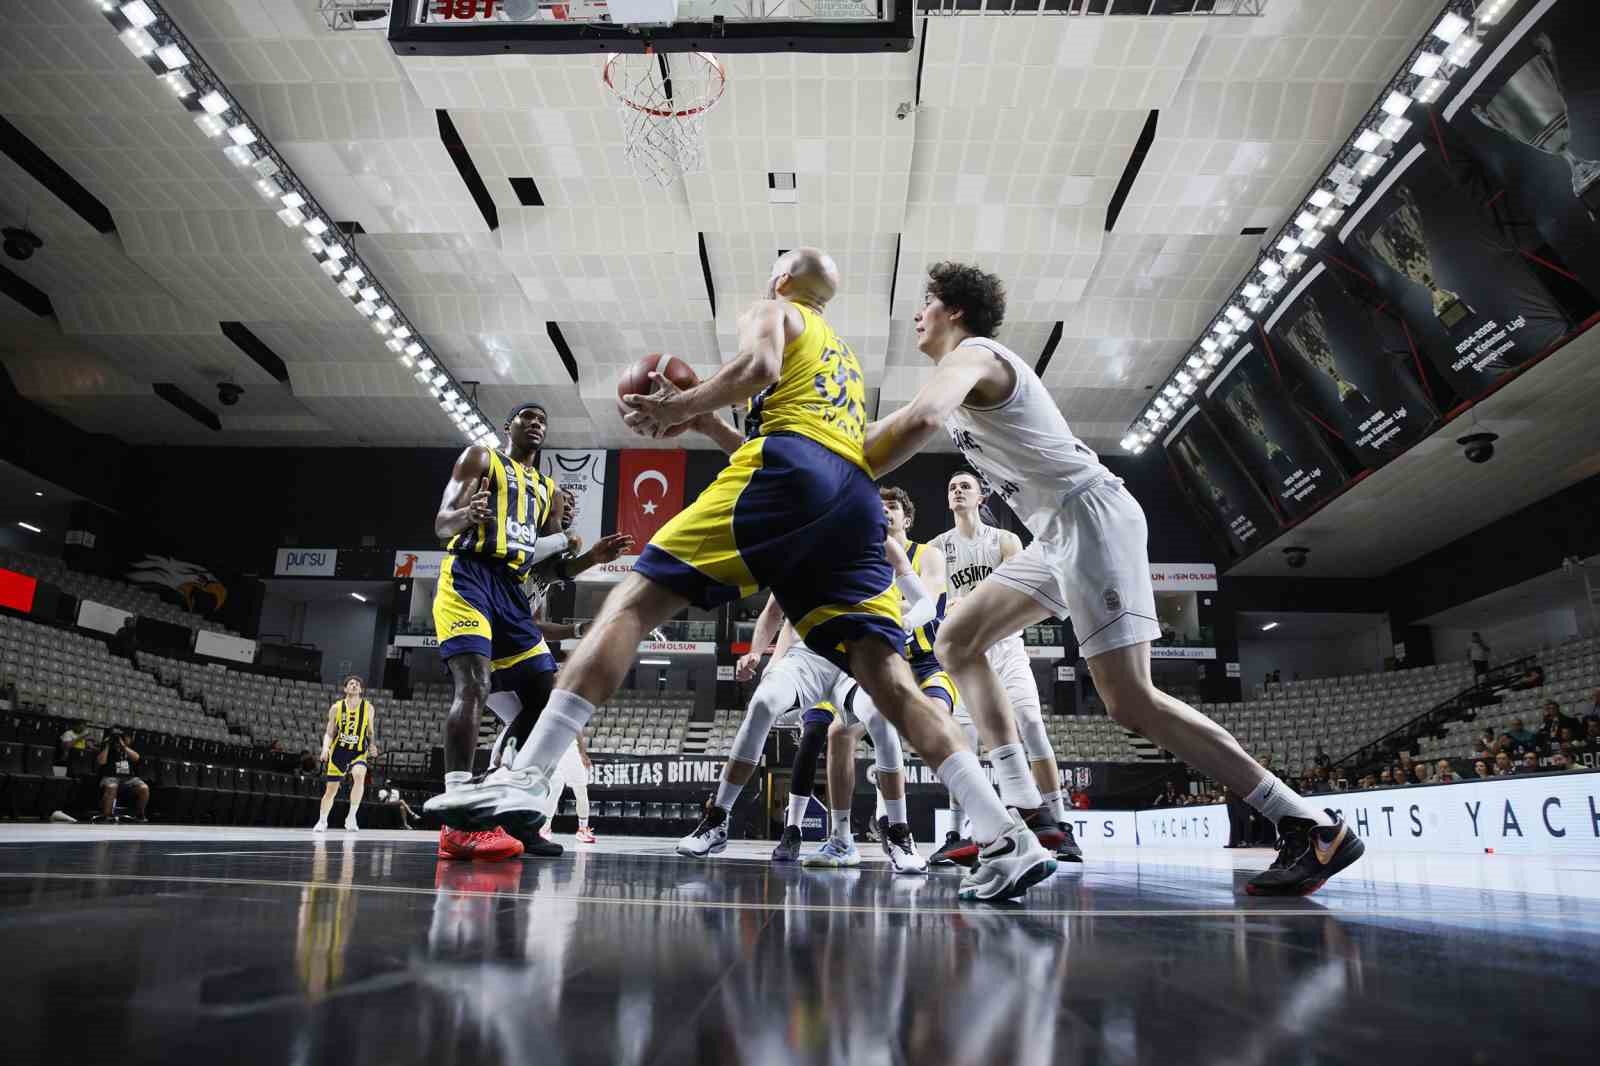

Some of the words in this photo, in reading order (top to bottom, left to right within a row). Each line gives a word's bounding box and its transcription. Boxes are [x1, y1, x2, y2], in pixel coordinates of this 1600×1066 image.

[287, 552, 326, 571] pursu
[949, 563, 993, 589] BEŞİKTA
[1153, 816, 1210, 838] YACHTS
[1333, 804, 1423, 838] HTS
